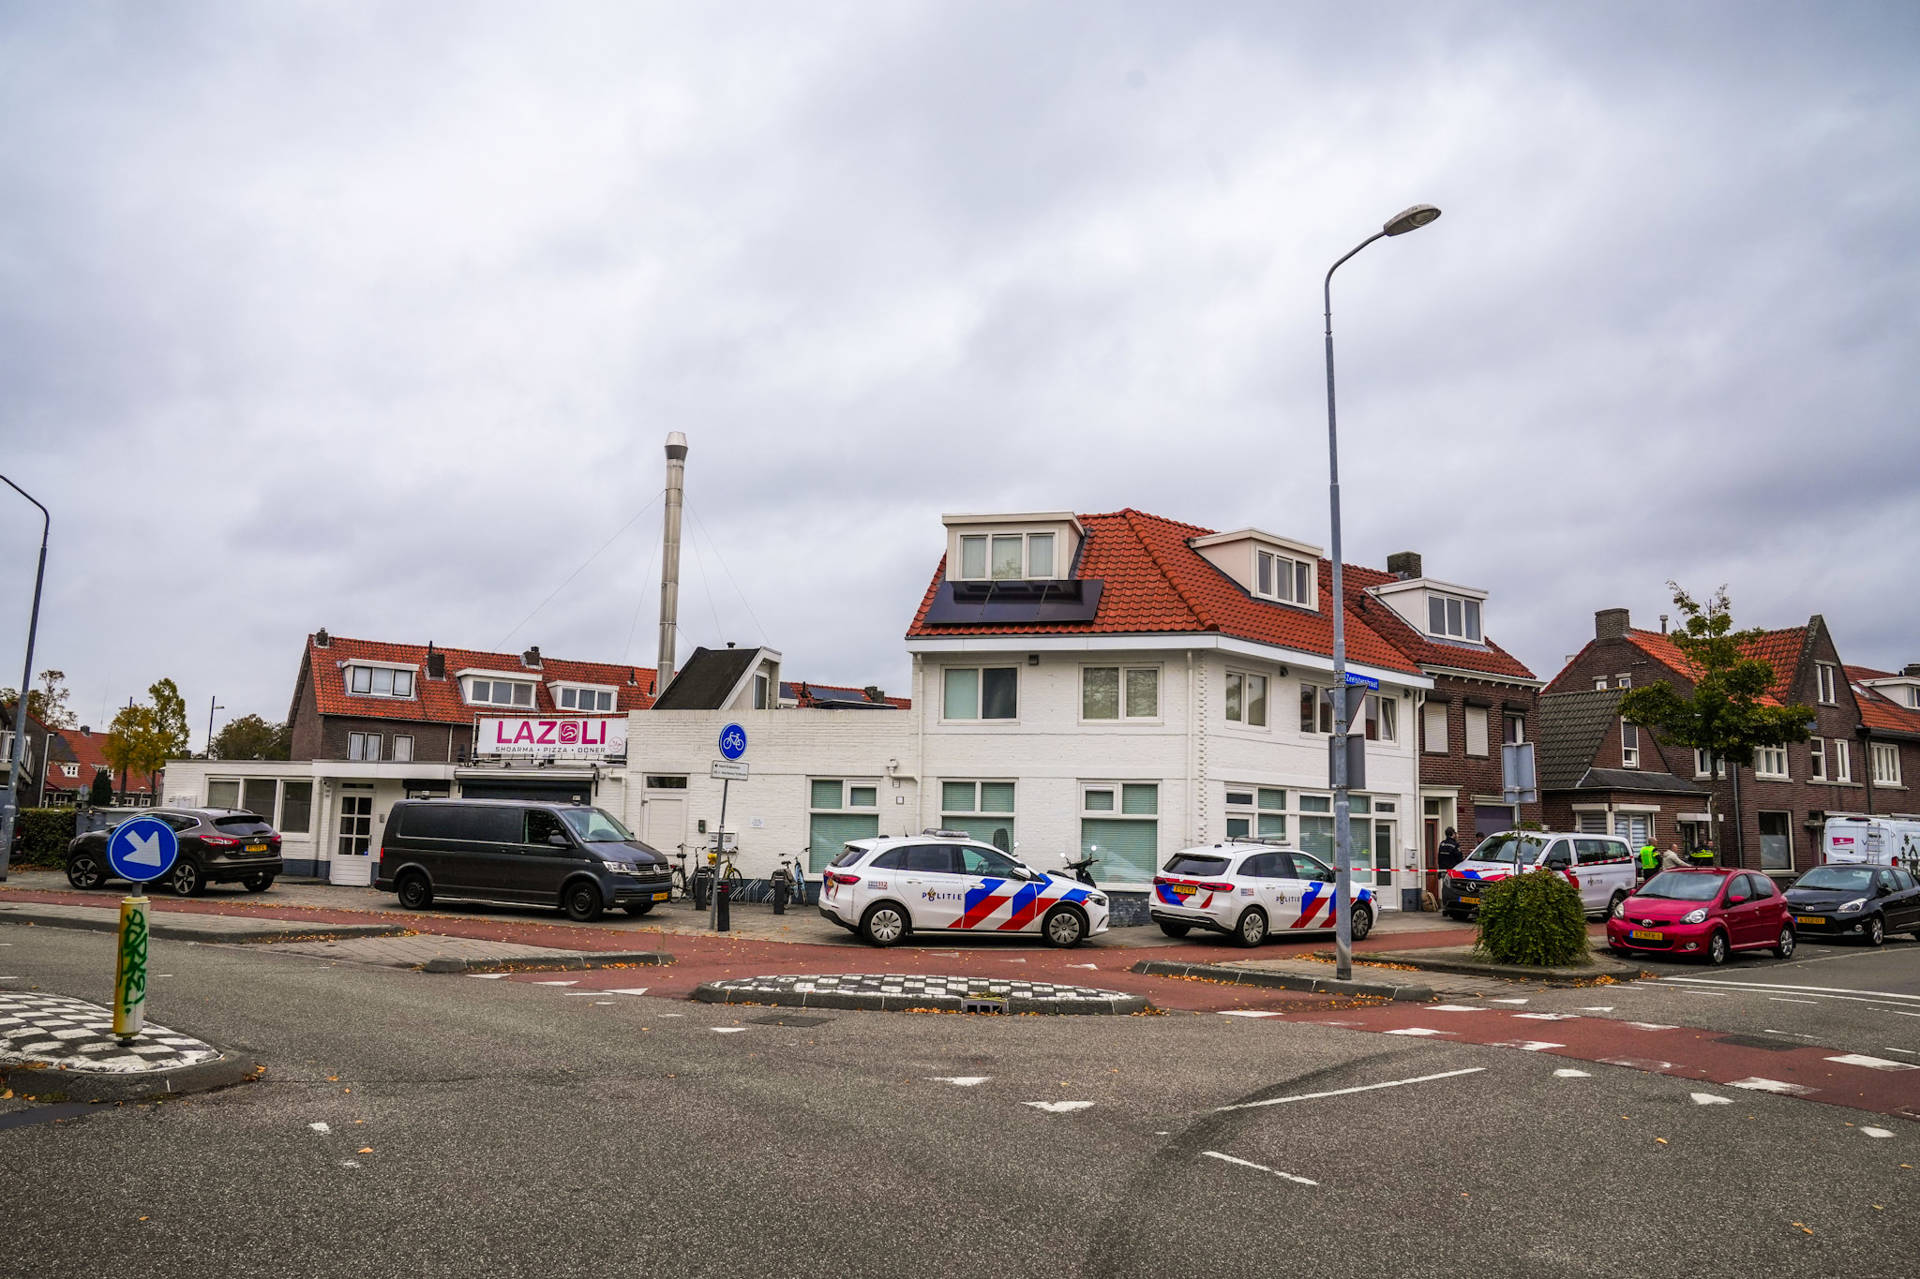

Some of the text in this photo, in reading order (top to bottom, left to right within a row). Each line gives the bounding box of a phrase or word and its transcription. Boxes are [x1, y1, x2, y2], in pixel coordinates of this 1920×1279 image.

[496, 720, 607, 745] LAZOLI
[495, 746, 535, 754] SHOARMA
[543, 746, 568, 754] PIZZA
[922, 892, 962, 902] POLITIE
